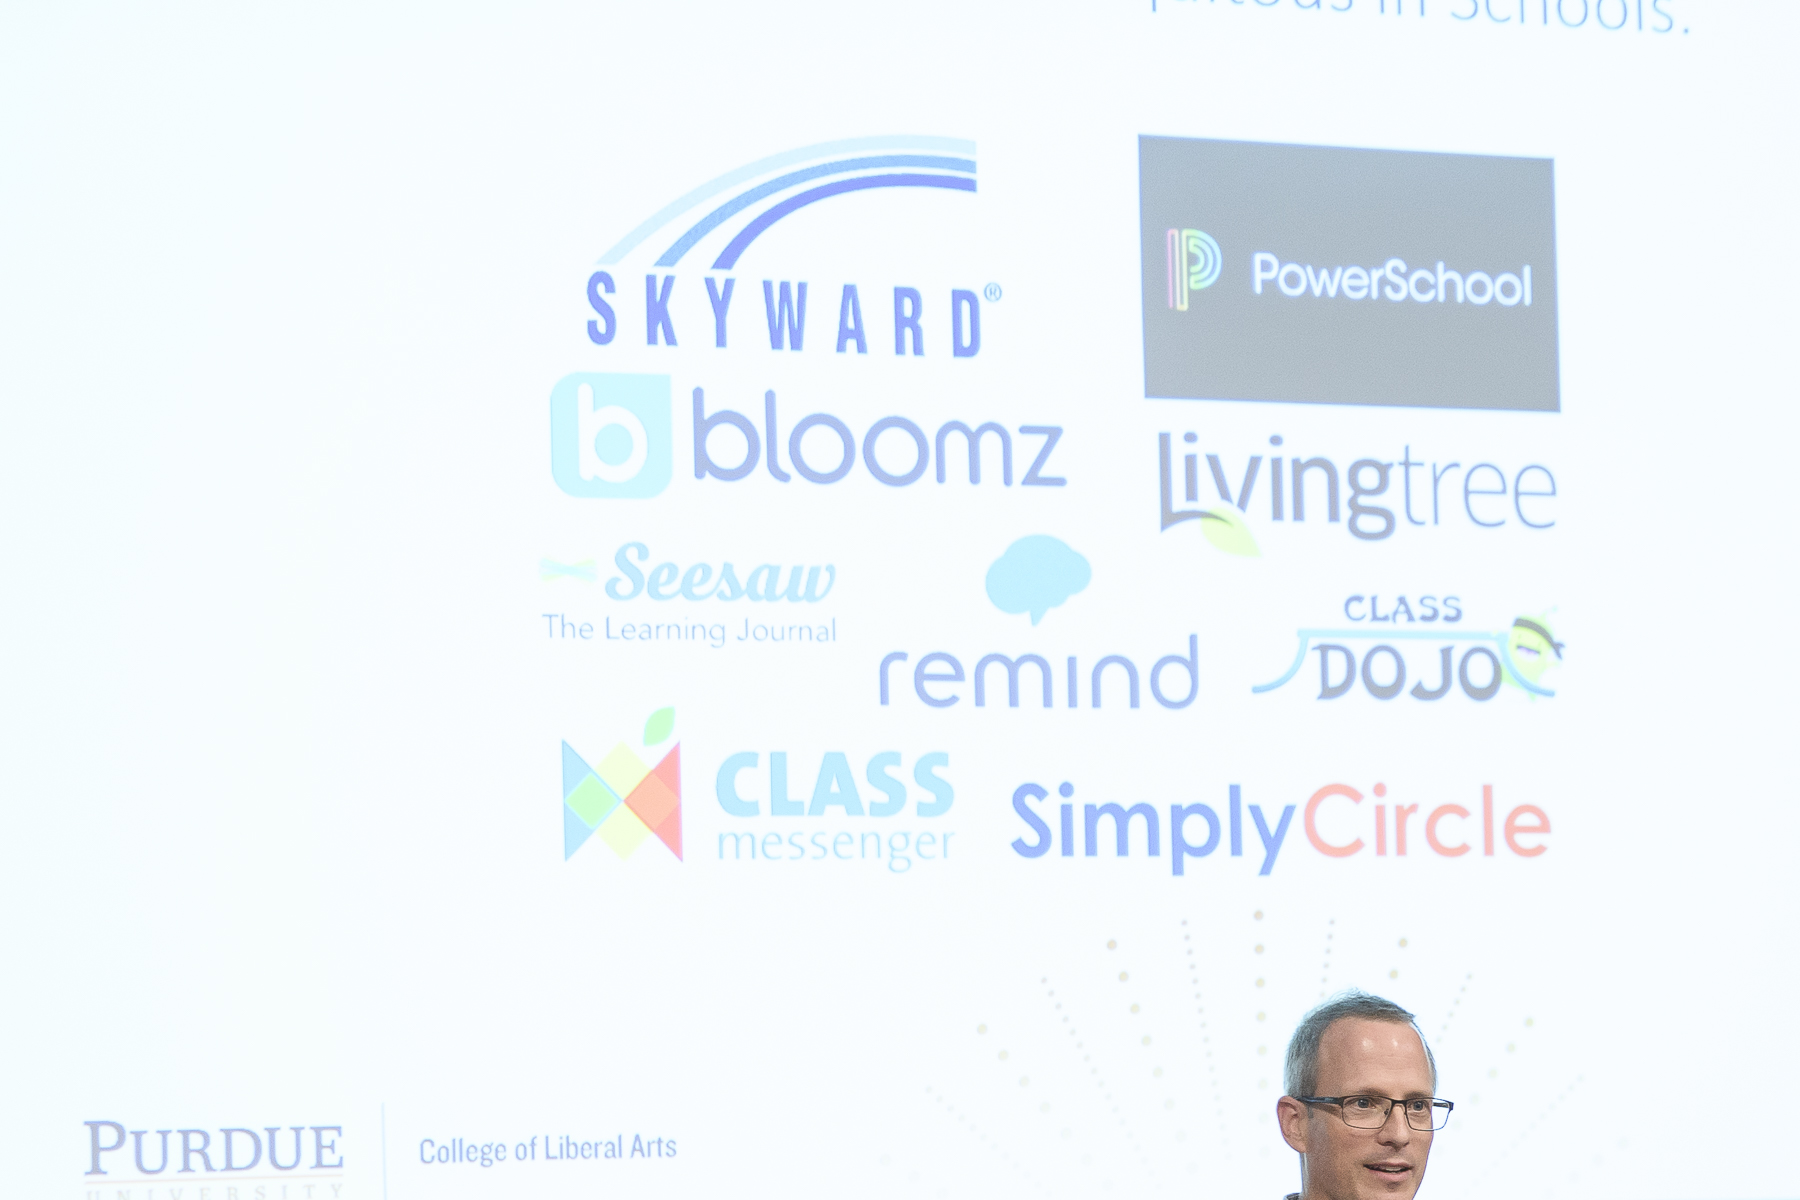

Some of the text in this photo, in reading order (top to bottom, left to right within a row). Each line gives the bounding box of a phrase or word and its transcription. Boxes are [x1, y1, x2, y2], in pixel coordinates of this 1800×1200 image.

[1253, 252, 1532, 306] PowerSchool
[692, 386, 1067, 487] bloomz
[1158, 431, 1557, 541] Livingtree
[604, 541, 836, 603] Seesaw
[542, 613, 837, 648] The Learning Journal
[1344, 595, 1463, 623] CLASS
[879, 633, 1199, 710] remind
[1312, 644, 1502, 701] DOJO
[715, 751, 955, 817] CLASS
[718, 831, 955, 873] messenger
[1011, 781, 1552, 876] SimplyCircle
[84, 1120, 344, 1175] PURDUE
[420, 1133, 677, 1168] College of Liberal Arts
